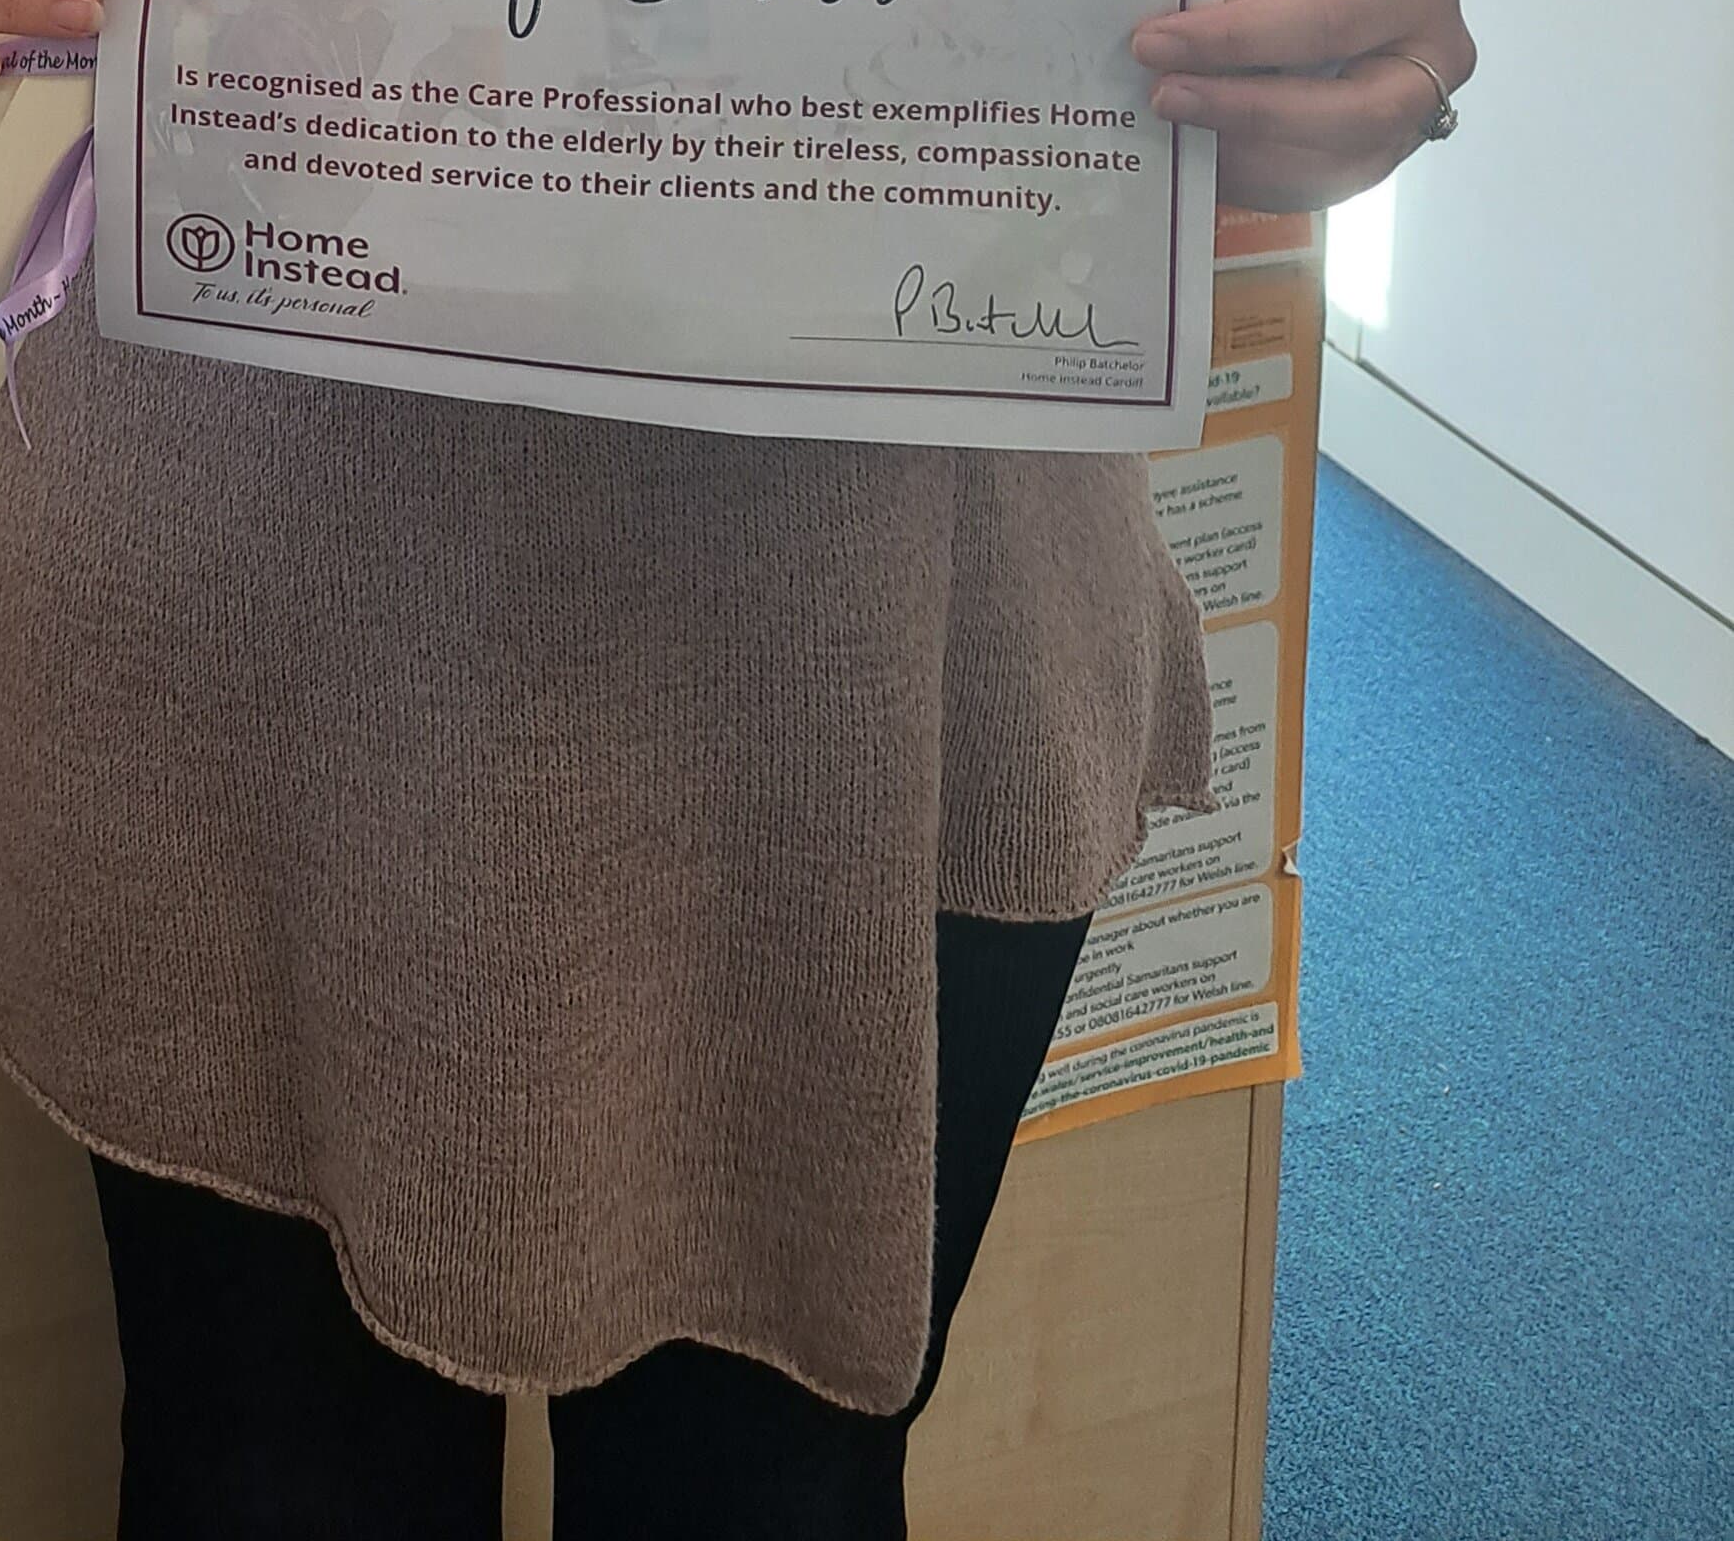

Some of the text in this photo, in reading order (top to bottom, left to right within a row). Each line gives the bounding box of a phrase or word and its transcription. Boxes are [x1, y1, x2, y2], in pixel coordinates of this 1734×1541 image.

[20, 50, 36, 73] of
[37, 49, 64, 69] the
[175, 63, 1136, 129] Is recognised as the Care Professional who best exemplifies Home
[304, 112, 458, 146] dedication
[466, 125, 497, 148] to
[505, 125, 554, 151] the
[561, 124, 663, 160] elderly
[671, 131, 707, 162] by
[713, 126, 785, 158] their
[792, 135, 907, 166] tireless,
[916, 143, 1141, 172] compassionate
[243, 149, 1061, 217] and devoted service to their clients and the community.
[245, 220, 370, 260] Home
[3, 297, 53, 335] Month
[271, 293, 377, 318] personal
[1055, 355, 1145, 373] Philip Batchelor
